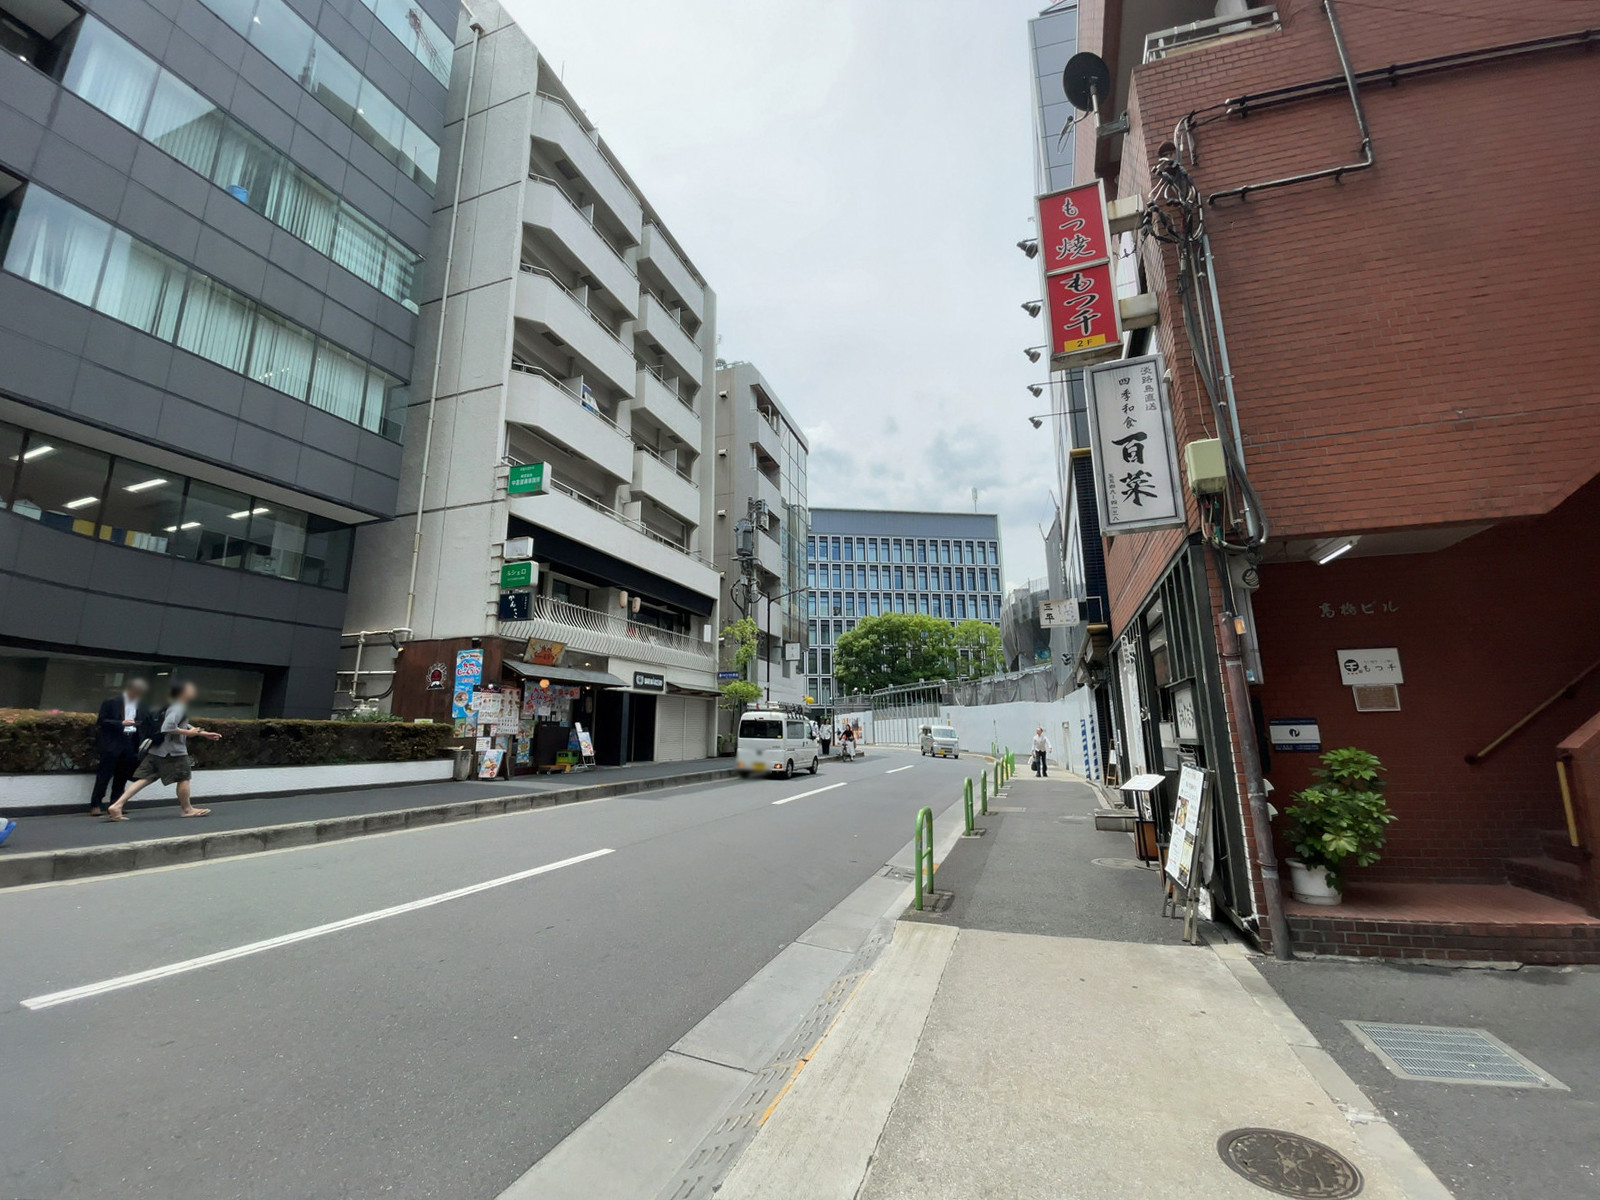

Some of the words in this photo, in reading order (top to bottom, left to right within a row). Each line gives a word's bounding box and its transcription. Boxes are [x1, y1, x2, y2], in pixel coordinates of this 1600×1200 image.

[1056, 197, 1095, 260] もつ焼
[1060, 272, 1101, 335] もつ千
[1118, 376, 1137, 429] 四季和食
[1111, 431, 1158, 507] 百菜
